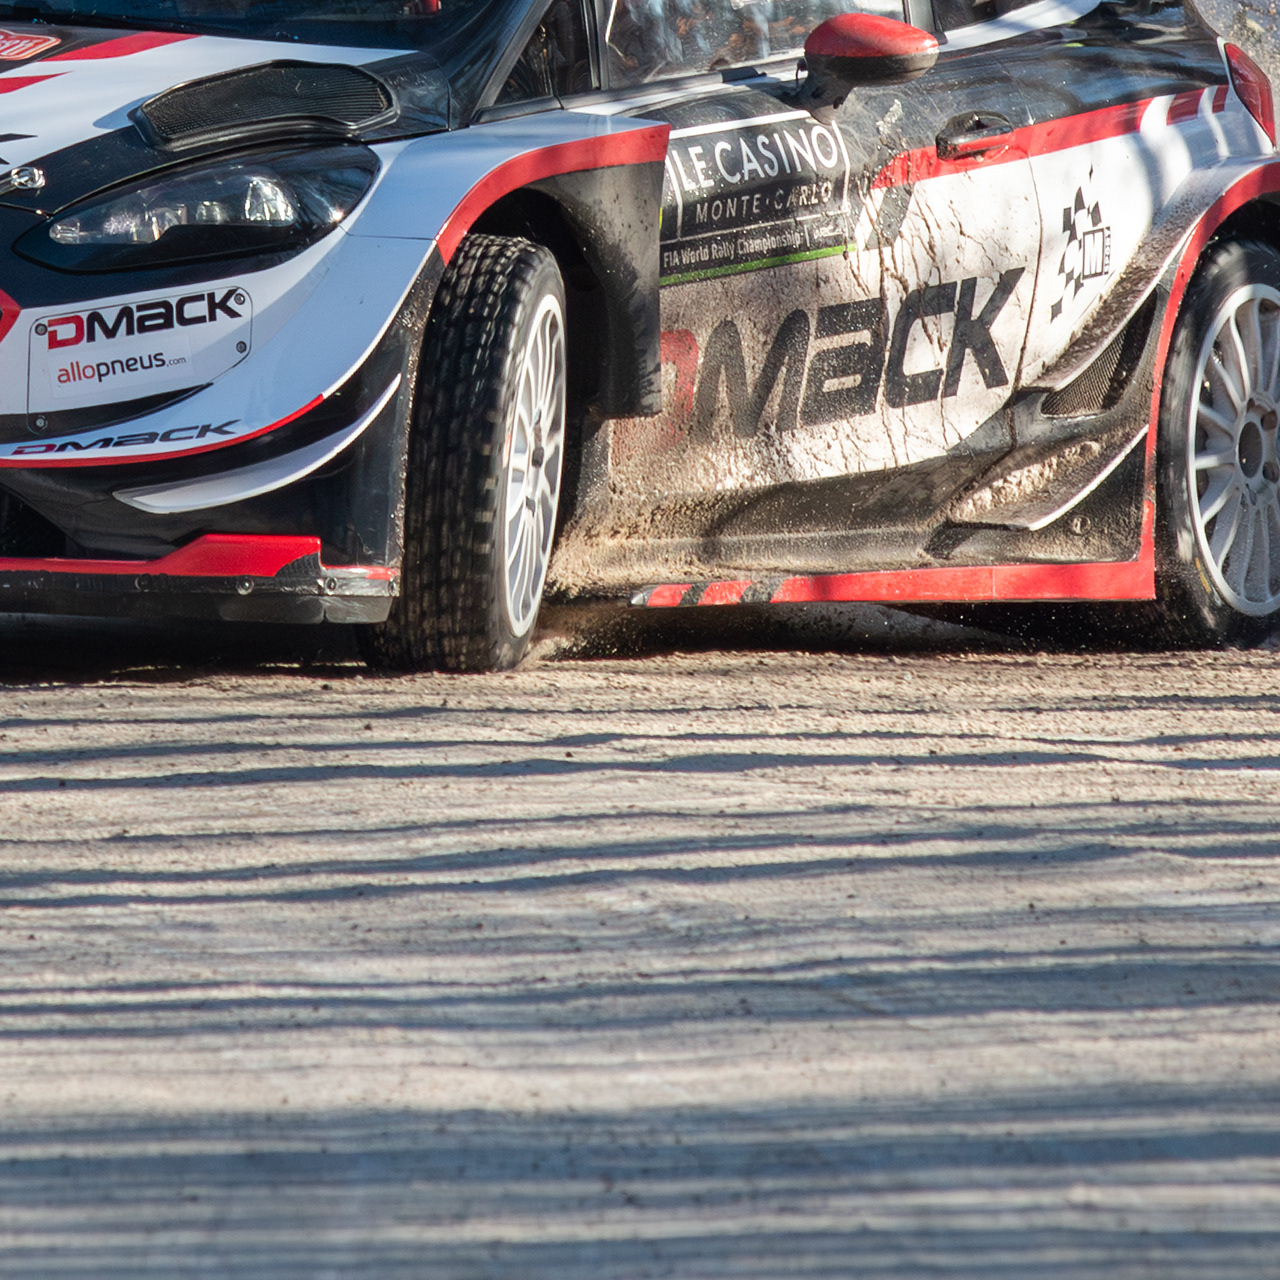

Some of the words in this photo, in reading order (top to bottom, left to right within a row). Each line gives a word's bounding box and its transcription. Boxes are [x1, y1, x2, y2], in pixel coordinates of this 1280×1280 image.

[672, 145, 715, 192] LE
[714, 124, 838, 184] CASINO
[663, 251, 680, 269] FIA
[682, 246, 710, 265] World
[711, 242, 735, 261] Rally
[57, 352, 187, 384] allopneus.com
